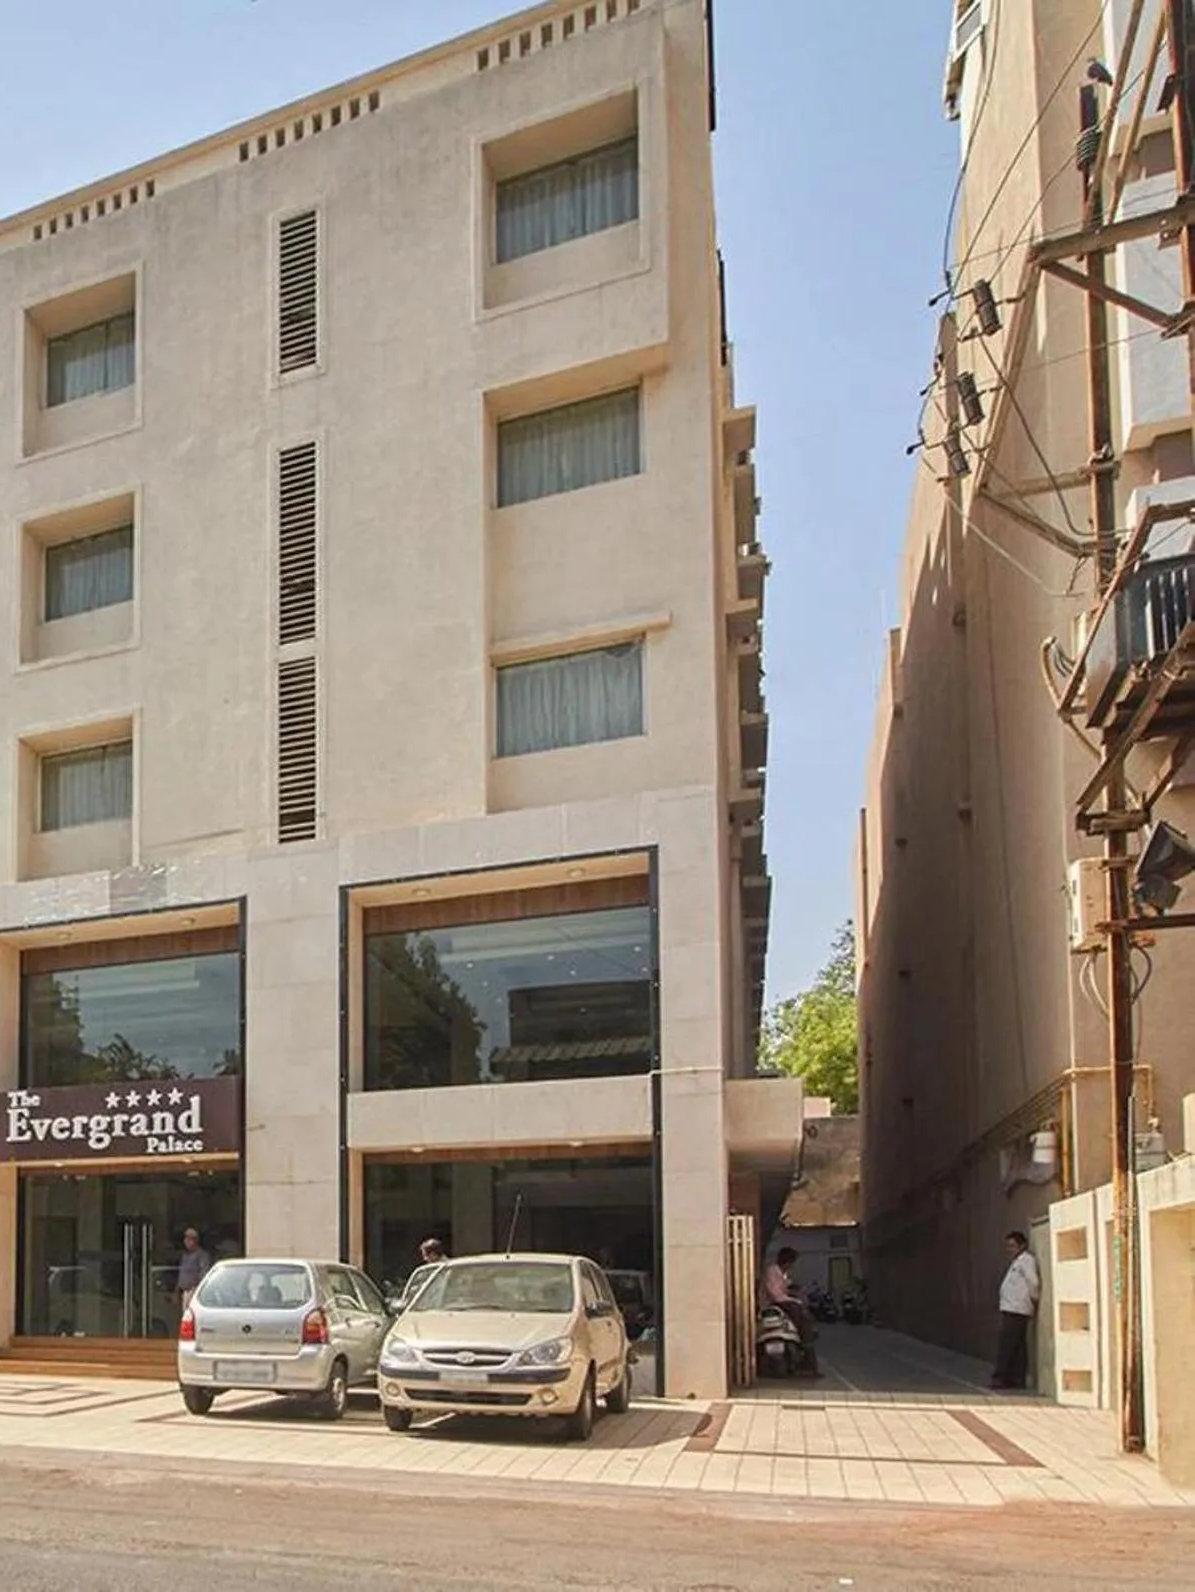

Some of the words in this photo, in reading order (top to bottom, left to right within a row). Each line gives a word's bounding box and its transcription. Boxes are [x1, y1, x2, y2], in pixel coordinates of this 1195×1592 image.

[7, 1090, 41, 1109] The
[6, 1095, 204, 1150] Evergrand
[145, 1136, 204, 1154] Palace
